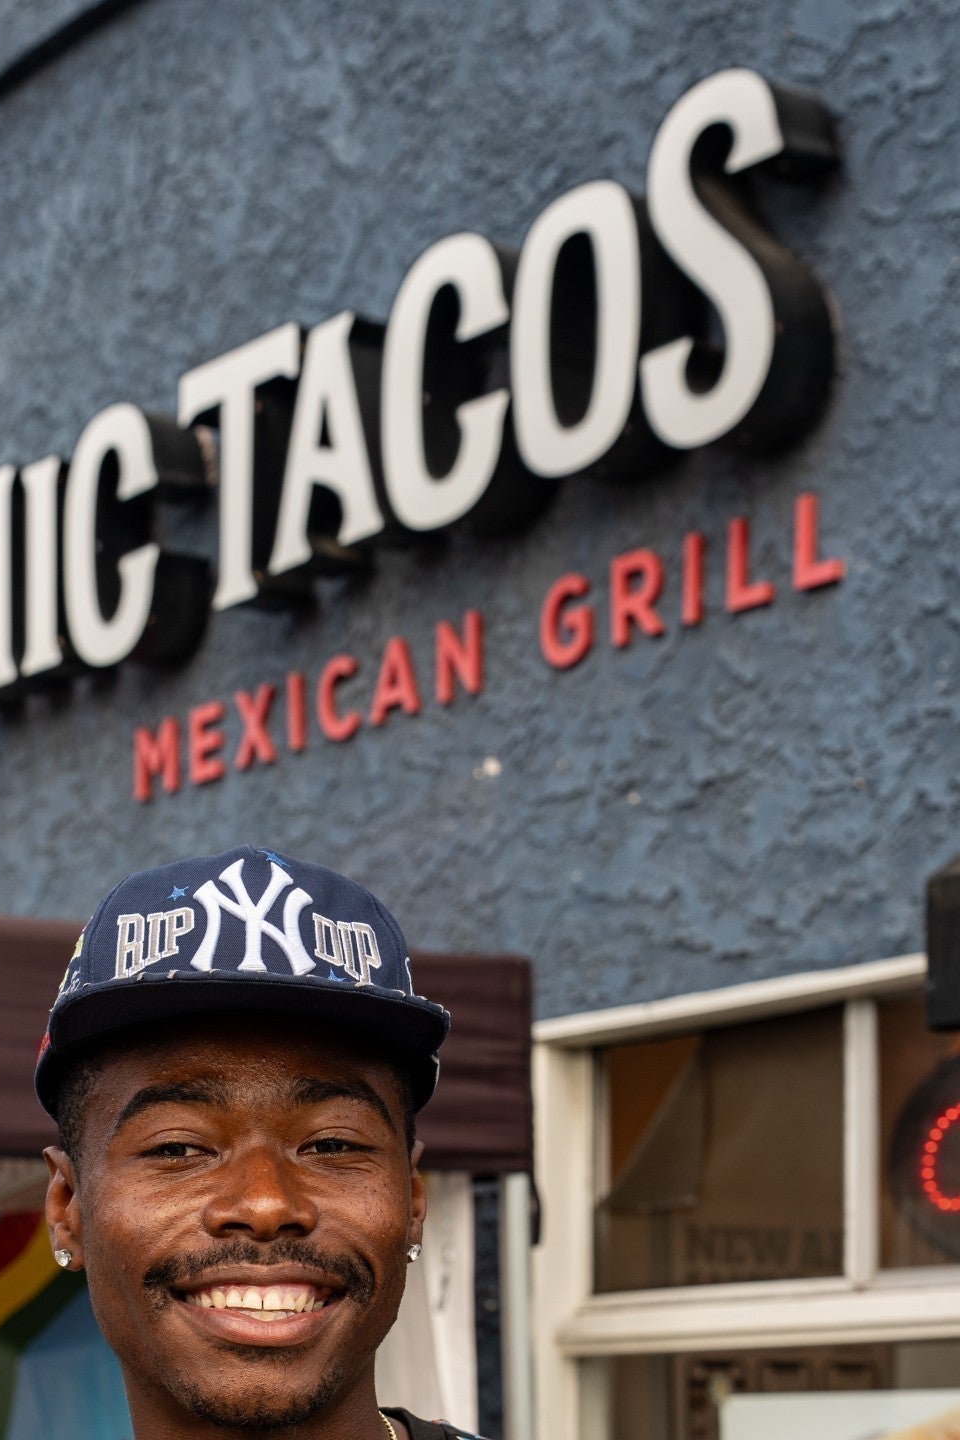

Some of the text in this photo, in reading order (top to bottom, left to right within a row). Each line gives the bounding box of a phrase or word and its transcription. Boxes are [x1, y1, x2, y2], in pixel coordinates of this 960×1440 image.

[178, 67, 786, 610] TACOS
[131, 492, 845, 801] MEXICAN GRILL
[190, 858, 317, 976] NY
[312, 911, 383, 986] DIP
